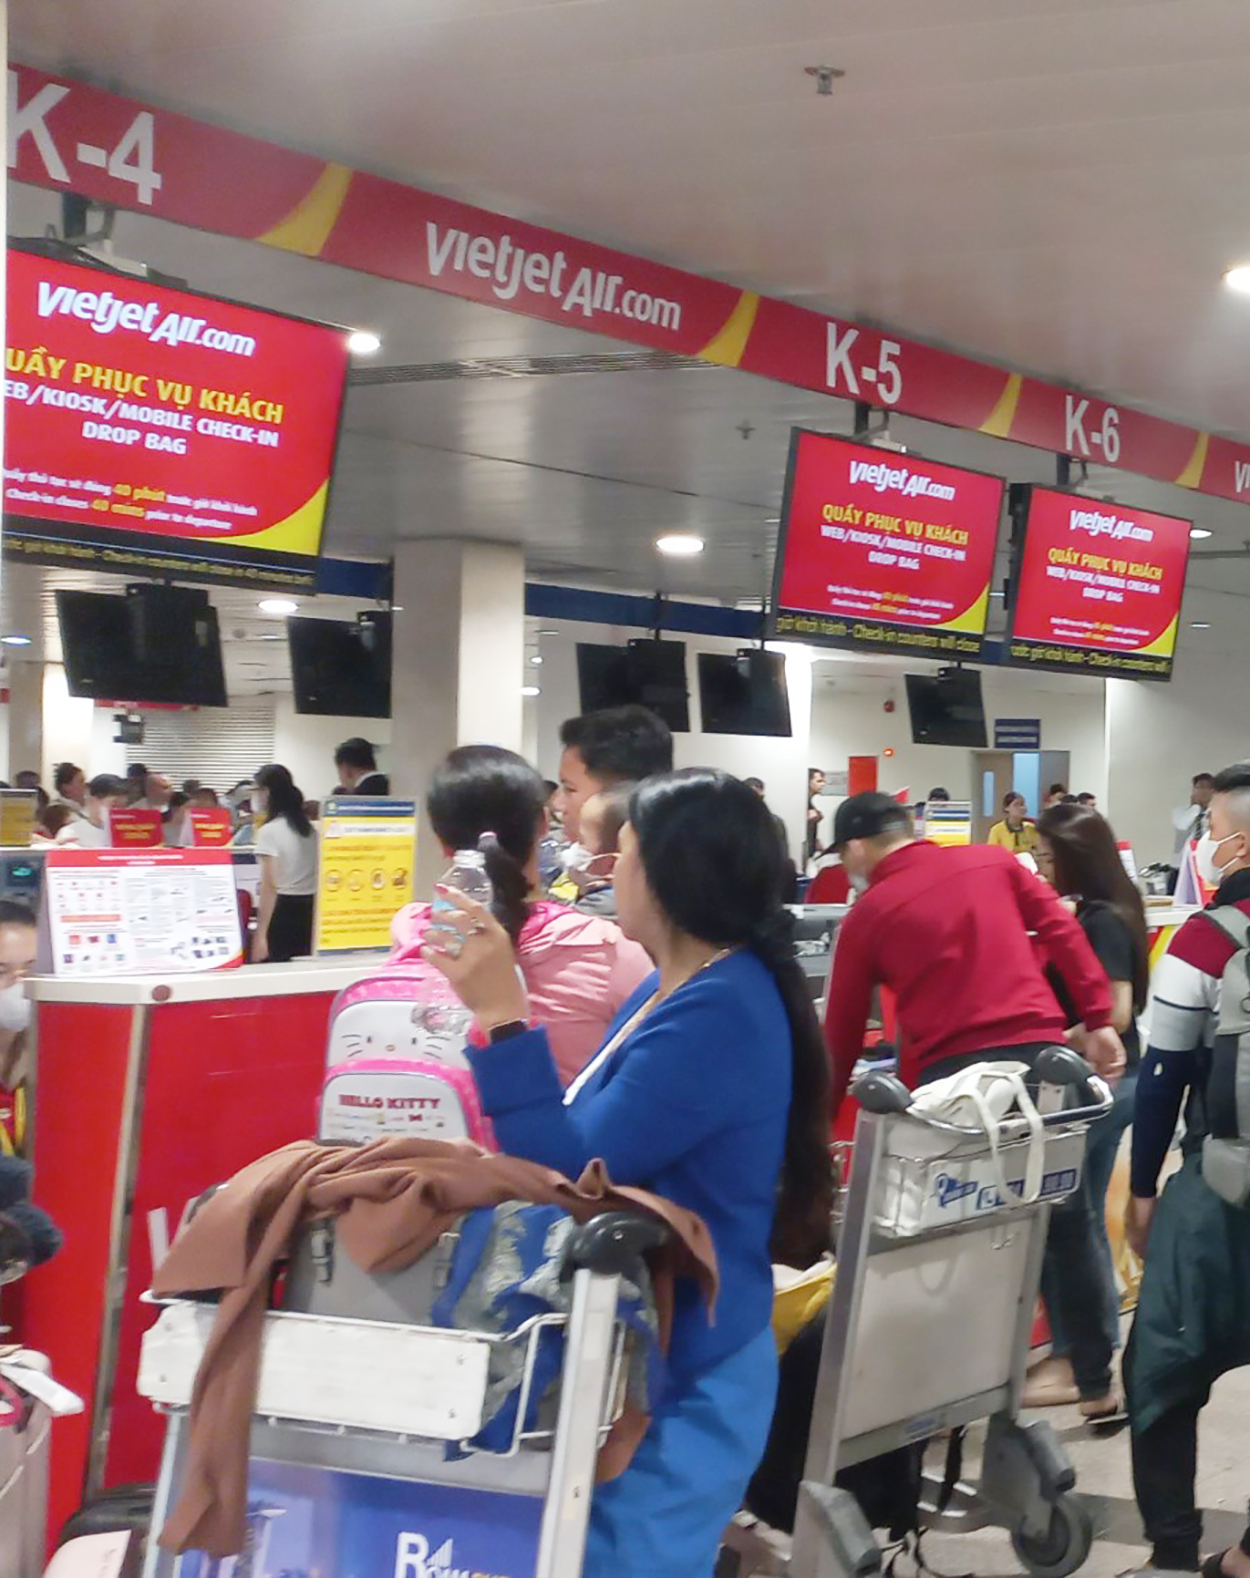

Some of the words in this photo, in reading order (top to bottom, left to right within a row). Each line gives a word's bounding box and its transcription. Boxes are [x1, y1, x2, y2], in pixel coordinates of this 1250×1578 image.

[6, 68, 163, 206] K-4
[826, 321, 902, 404] K-5
[73, 362, 149, 398] PHỤC
[156, 379, 193, 410] VỤ
[199, 389, 284, 425] KHÁCH
[82, 420, 141, 445] DROP
[145, 433, 187, 454] BAG
[197, 417, 279, 447] CHECK-IN
[1066, 394, 1120, 463] K-6
[905, 520, 923, 540] VỤ
[926, 520, 968, 545] KHÁCH
[338, 1094, 384, 1109] HELLO
[387, 1097, 441, 1109] KITTY
